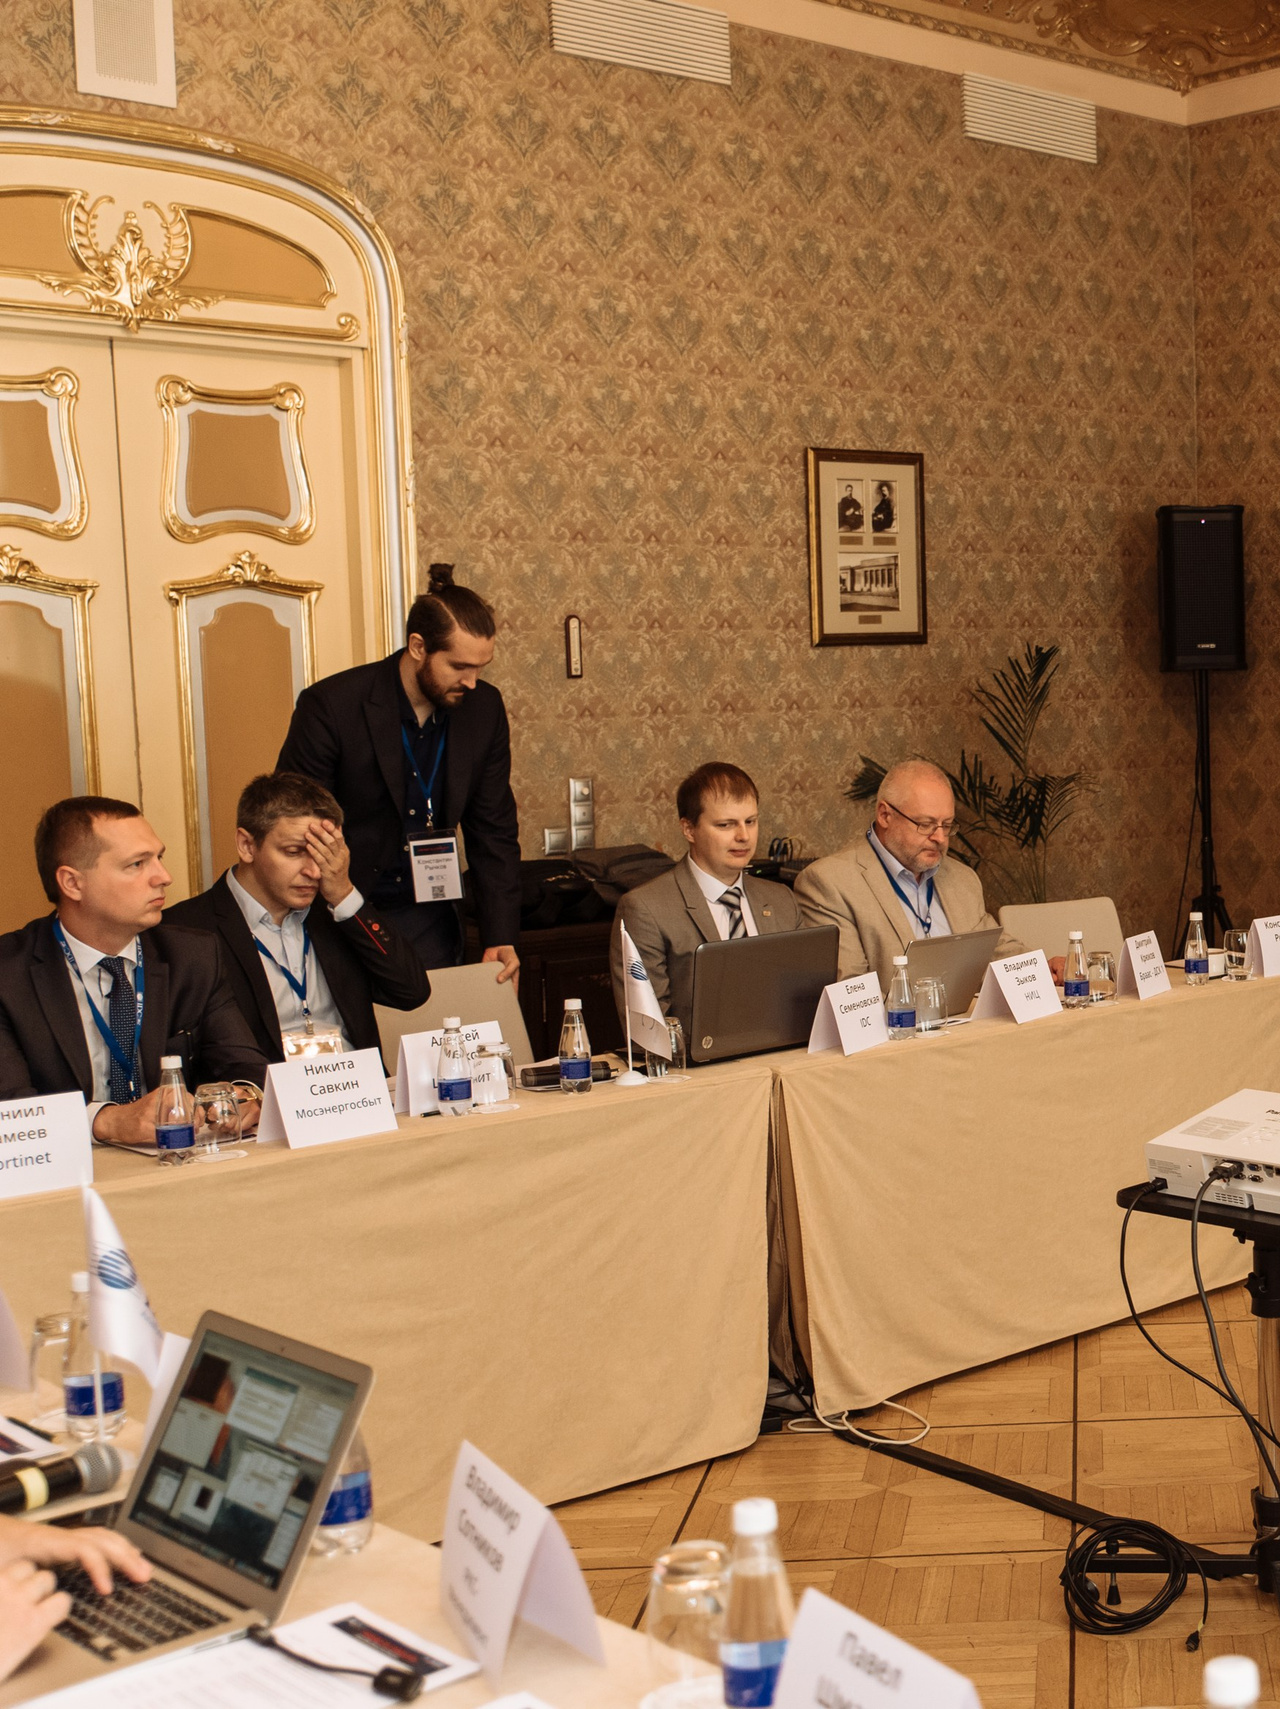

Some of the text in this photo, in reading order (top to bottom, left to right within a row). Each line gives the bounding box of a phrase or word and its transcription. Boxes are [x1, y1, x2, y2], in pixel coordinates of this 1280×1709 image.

[1003, 957, 1038, 973] Владимир
[845, 982, 866, 994] Елена
[1015, 974, 1037, 986] Зыков
[1024, 990, 1041, 1002] НИЦ
[839, 995, 880, 1014] Семеновская
[860, 1016, 872, 1028] IDC
[304, 1060, 355, 1076] Никита
[310, 1080, 360, 1096] Савкин
[295, 1097, 383, 1119] Мосэнергосбыт
